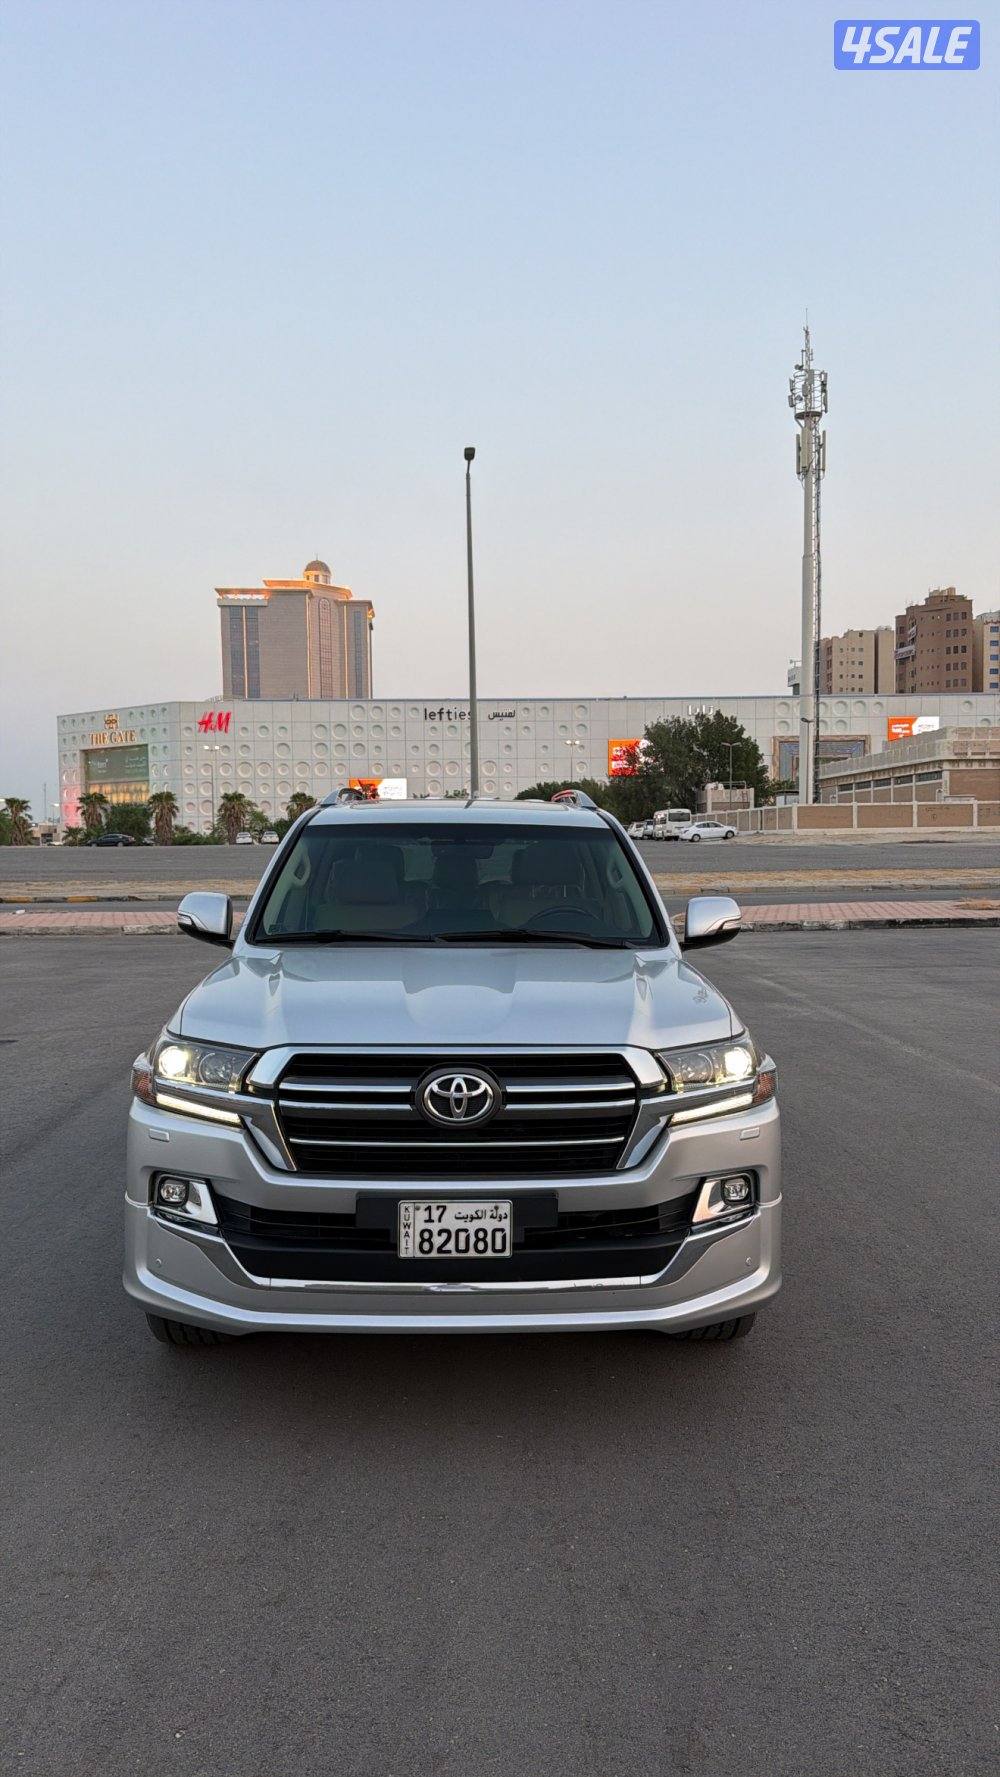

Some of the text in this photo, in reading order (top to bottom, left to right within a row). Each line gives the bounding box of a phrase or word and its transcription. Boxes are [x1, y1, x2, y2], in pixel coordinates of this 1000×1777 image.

[197, 711, 232, 734] H&M
[88, 730, 136, 746] THE GATE
[423, 1205, 447, 1223] 17
[454, 1209, 508, 1223] دولة الكويت
[403, 1205, 411, 1255] KUWAIT
[418, 1227, 507, 1255] 82080
